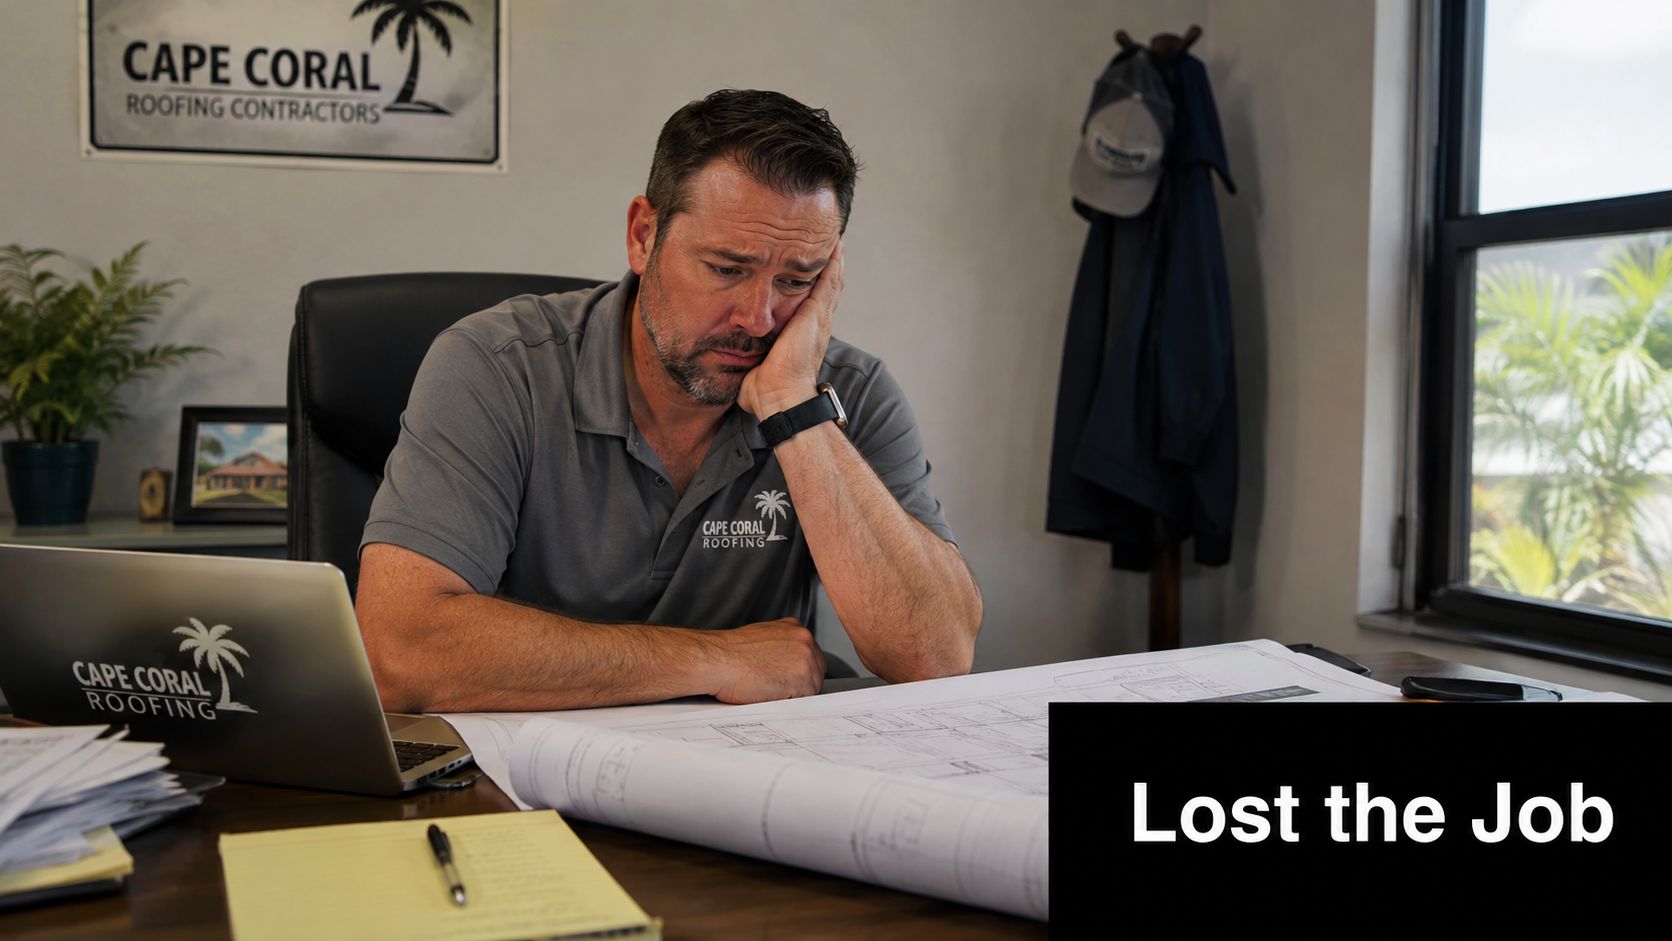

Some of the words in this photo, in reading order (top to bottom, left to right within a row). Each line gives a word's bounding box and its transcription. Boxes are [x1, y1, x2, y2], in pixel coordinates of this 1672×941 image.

[123, 41, 231, 85] CAPE
[244, 47, 381, 92] CORAL
[126, 93, 224, 119] ROOFING
[230, 97, 381, 124] CONTRACTORS
[702, 520, 728, 535] CAPE
[730, 520, 766, 535] CORAL
[703, 537, 765, 549] ROOFING
[72, 661, 133, 690] CAPE
[134, 666, 212, 697] CORAL
[86, 691, 217, 720] ROOFING
